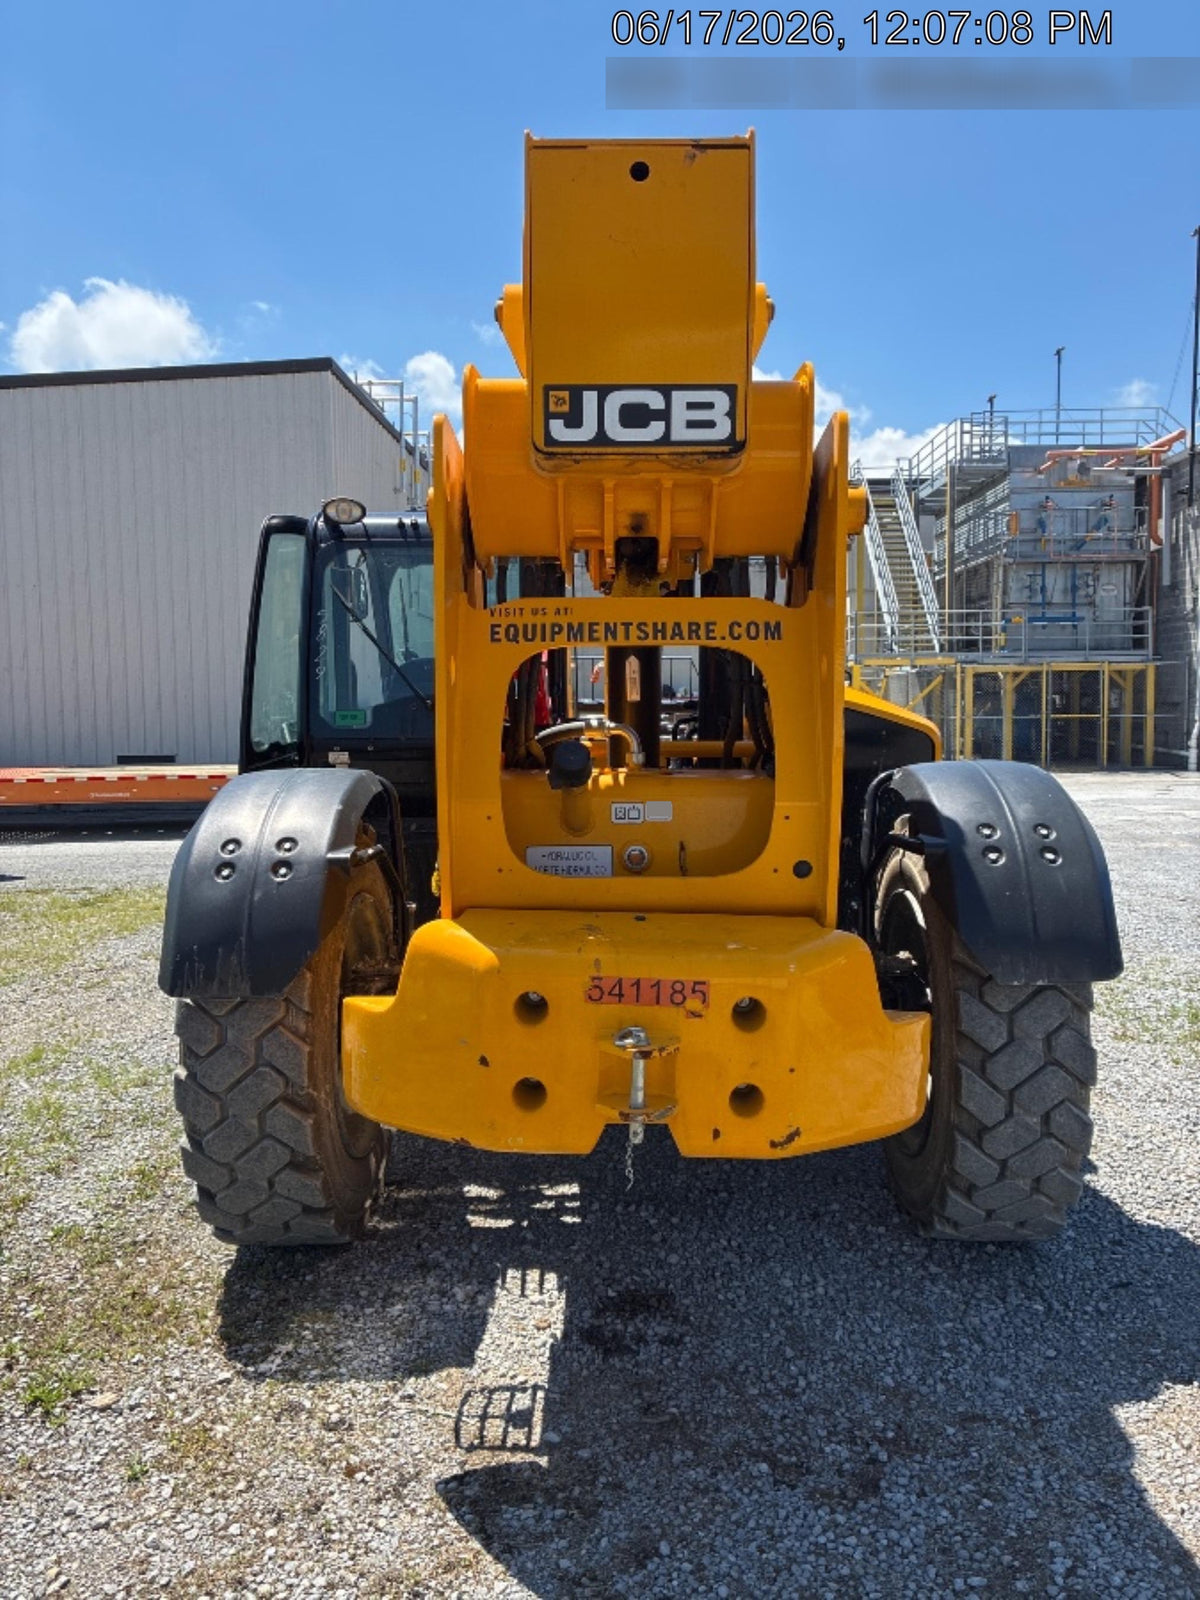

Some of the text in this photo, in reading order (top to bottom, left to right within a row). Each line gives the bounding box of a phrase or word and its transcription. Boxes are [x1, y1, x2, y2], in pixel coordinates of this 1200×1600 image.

[548, 389, 732, 442] JCB
[490, 607, 525, 618] VISIT
[531, 607, 548, 616] US
[490, 621, 782, 644] EQUIPMENTSHARE.COM
[587, 976, 707, 1010] 541185
